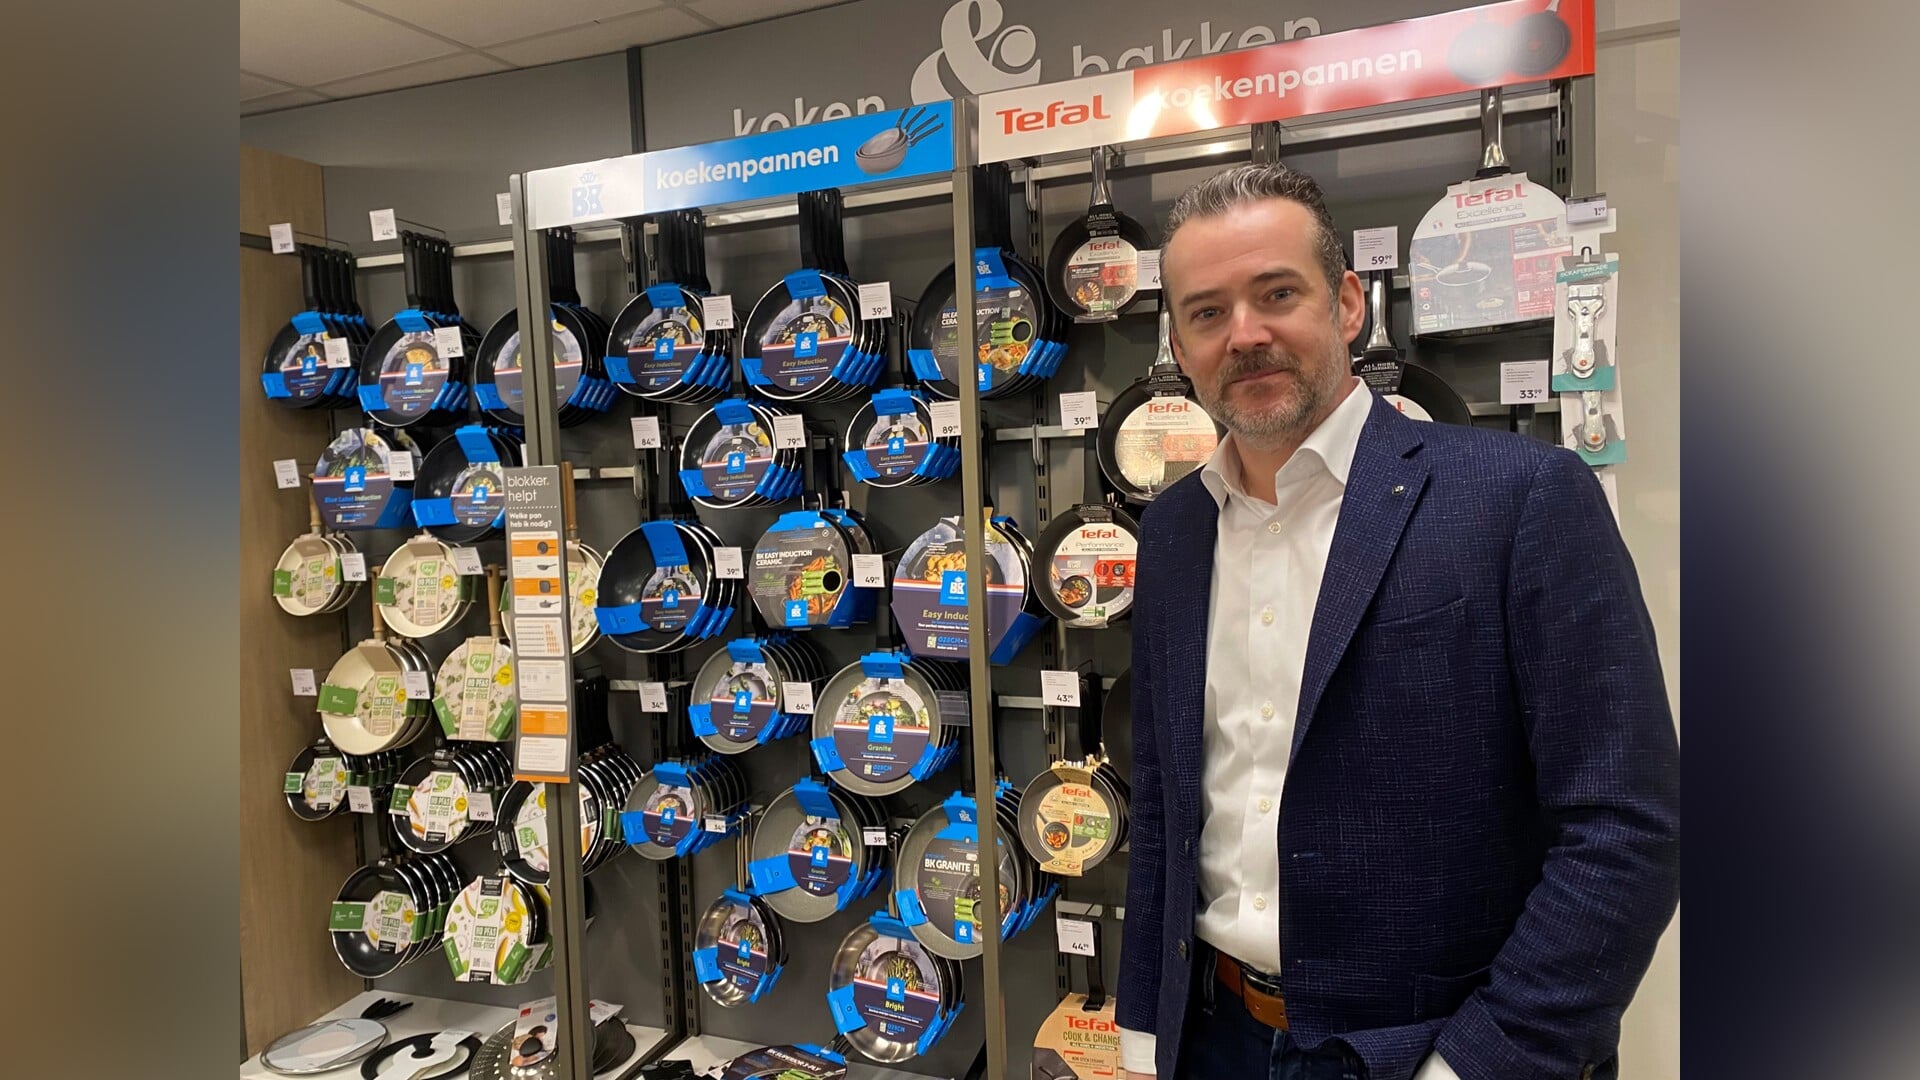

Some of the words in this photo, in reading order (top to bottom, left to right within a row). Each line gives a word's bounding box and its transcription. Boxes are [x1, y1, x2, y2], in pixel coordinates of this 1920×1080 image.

[1154, 46, 1423, 108] koekenpannen
[996, 95, 1110, 135] Tefal
[655, 144, 839, 191] koekenpannen
[1450, 183, 1528, 209] Tefal
[1456, 203, 1523, 220] Excellence
[1088, 241, 1121, 251] Tefal
[797, 357, 827, 366] Induction
[1146, 402, 1191, 413] Tefal
[507, 475, 550, 488] blokker.
[508, 490, 537, 503] helpt
[530, 520, 553, 528] nodig?
[1080, 528, 1120, 539] Tefal
[779, 549, 812, 558] INDUCTION
[922, 609, 943, 620] Easy
[867, 744, 892, 752] Granite
[1061, 786, 1092, 799] Tefal
[924, 858, 936, 869] BK
[936, 860, 971, 872] GRANITE
[885, 1001, 905, 1012] Bright
[1064, 1015, 1119, 1033] Tefal
[1063, 1030, 1082, 1042] COOK
[1084, 1032, 1091, 1042] &
